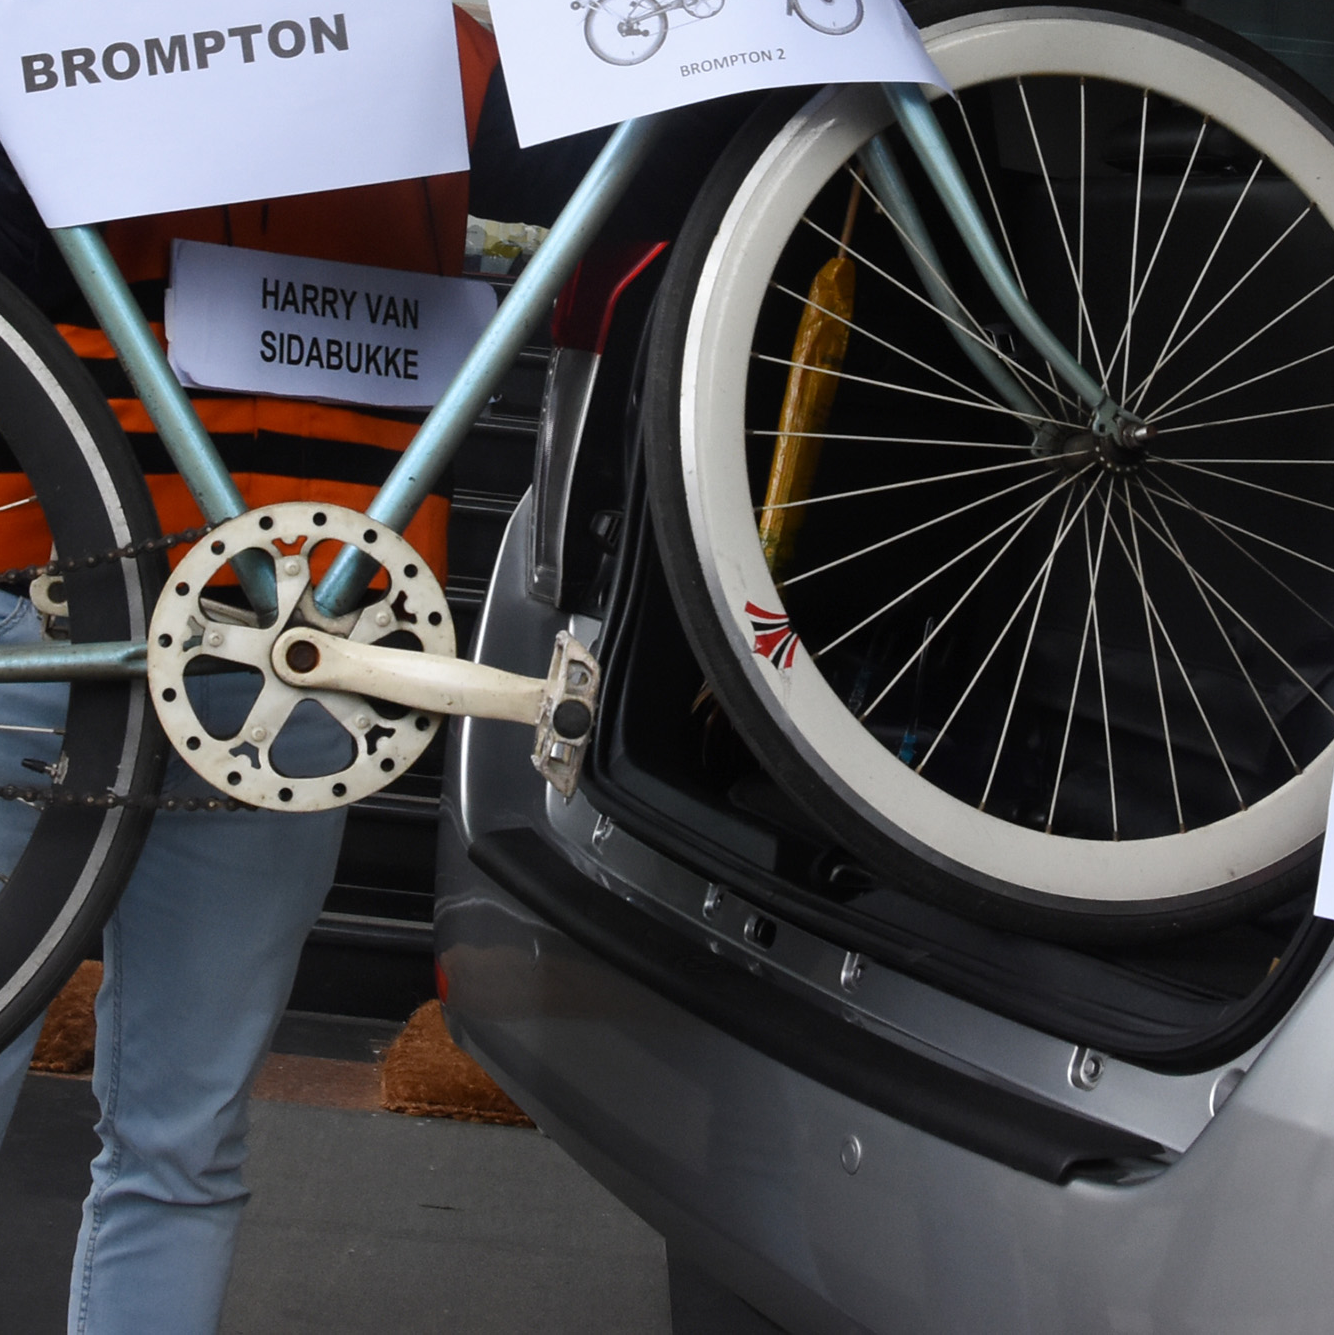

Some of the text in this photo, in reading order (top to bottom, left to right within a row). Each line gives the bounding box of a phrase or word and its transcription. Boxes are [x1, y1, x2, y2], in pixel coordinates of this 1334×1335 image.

[20, 13, 350, 93] BROMPTON
[679, 48, 786, 77] BROMPTON 2
[261, 277, 419, 330] HARRY VAN
[260, 330, 419, 380] SIDABUKKE
